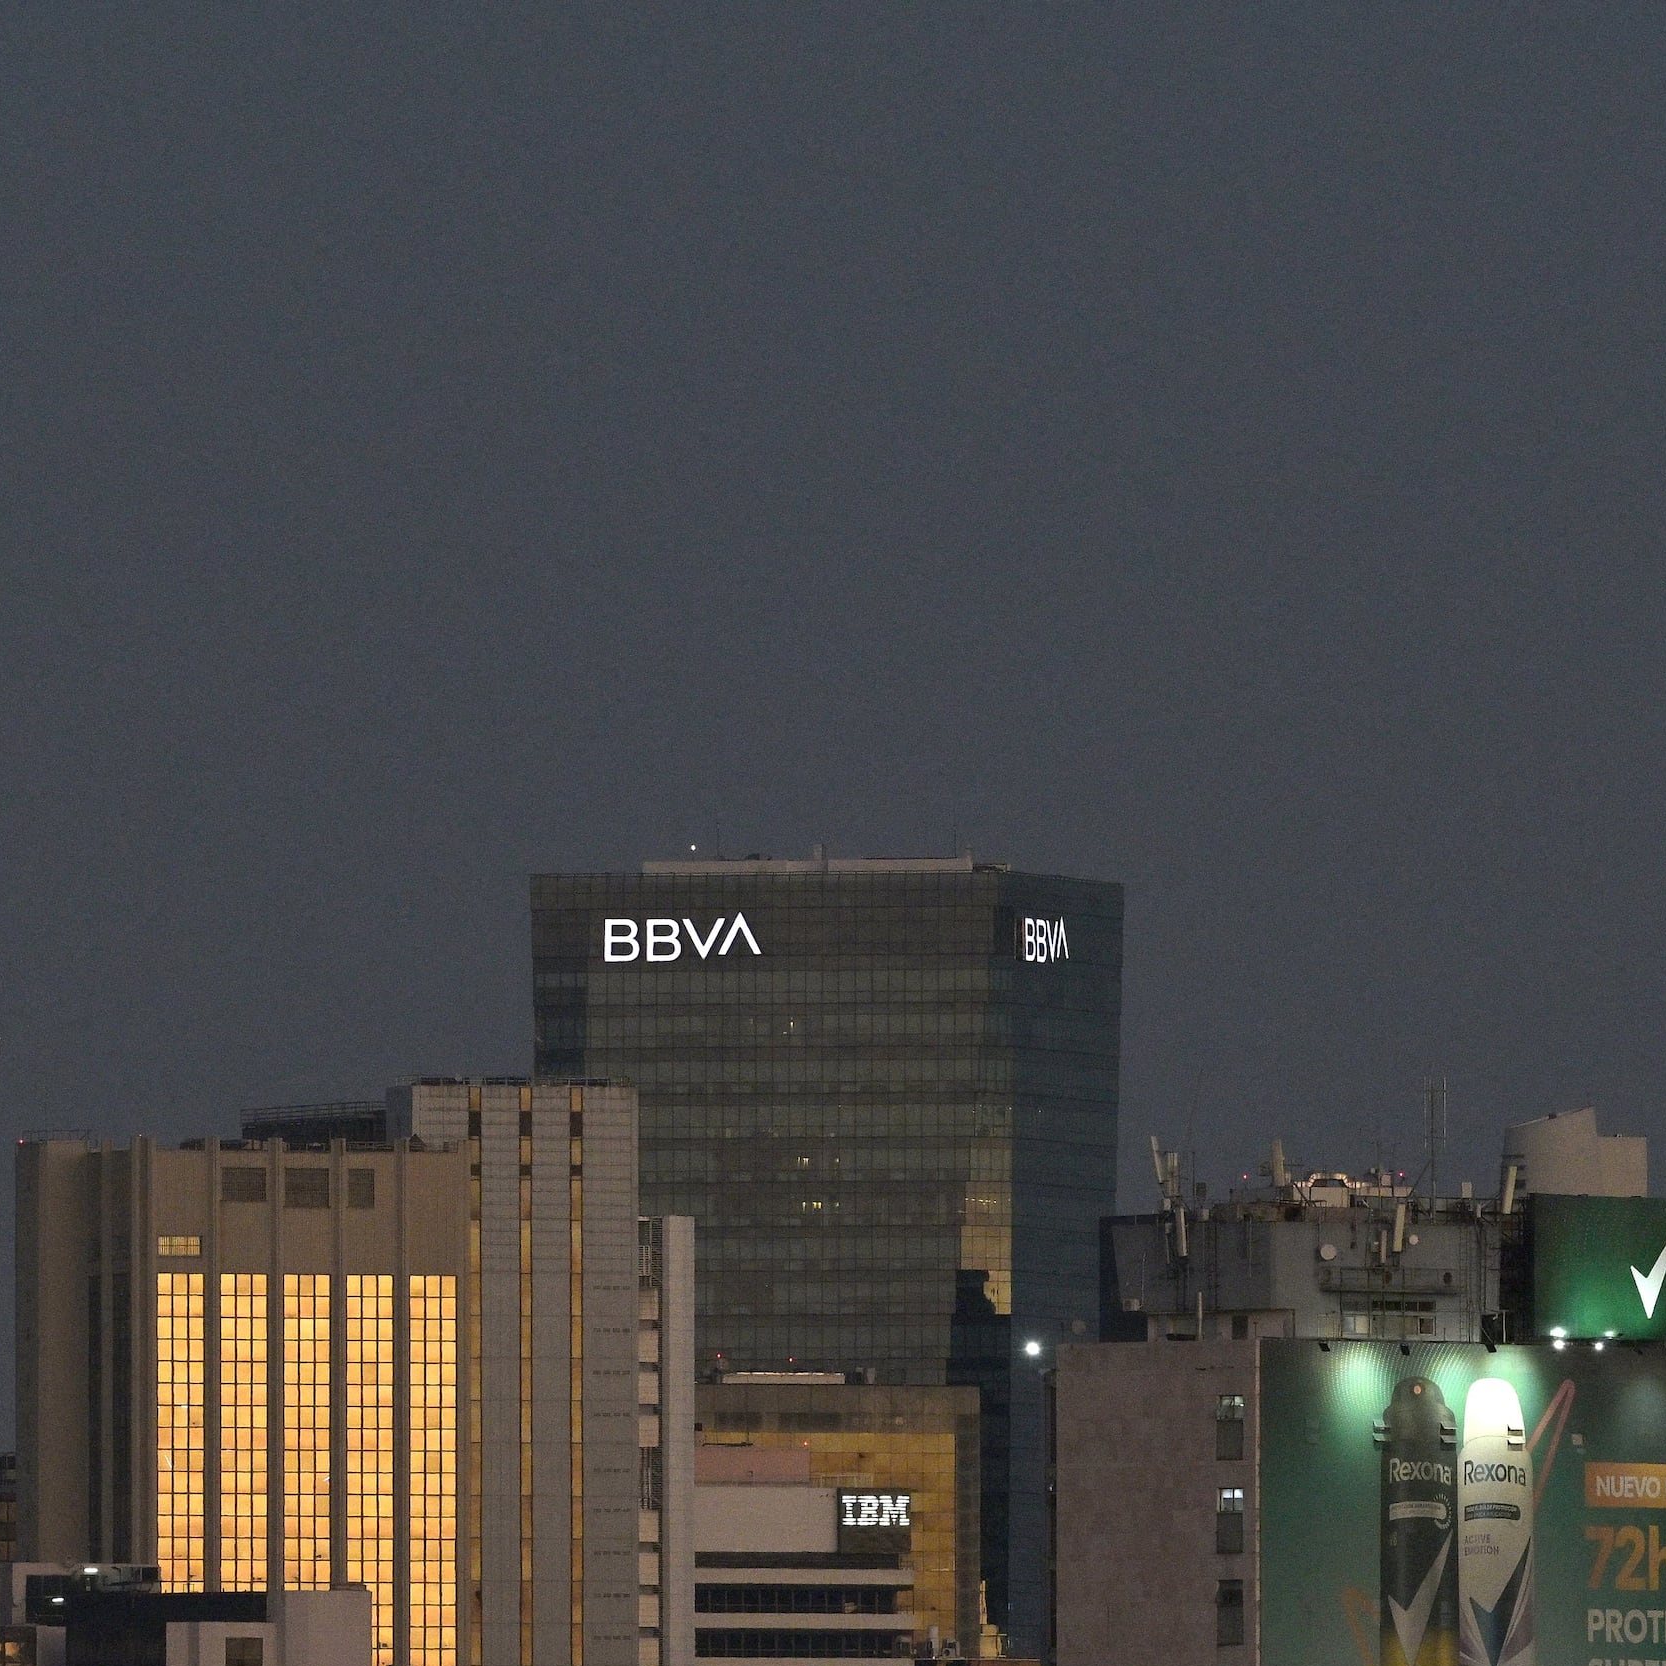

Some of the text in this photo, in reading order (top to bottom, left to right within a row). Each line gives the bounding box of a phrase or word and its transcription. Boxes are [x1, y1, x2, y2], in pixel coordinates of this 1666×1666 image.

[603, 911, 762, 963] BBVA
[1024, 916, 1070, 964] BBVA
[1389, 1457, 1452, 1486] Rexona
[1464, 1459, 1527, 1487] Rexona
[1595, 1475, 1661, 1499] NUEVO
[841, 1495, 911, 1527] IBM
[1464, 1546, 1499, 1556] EMOTION
